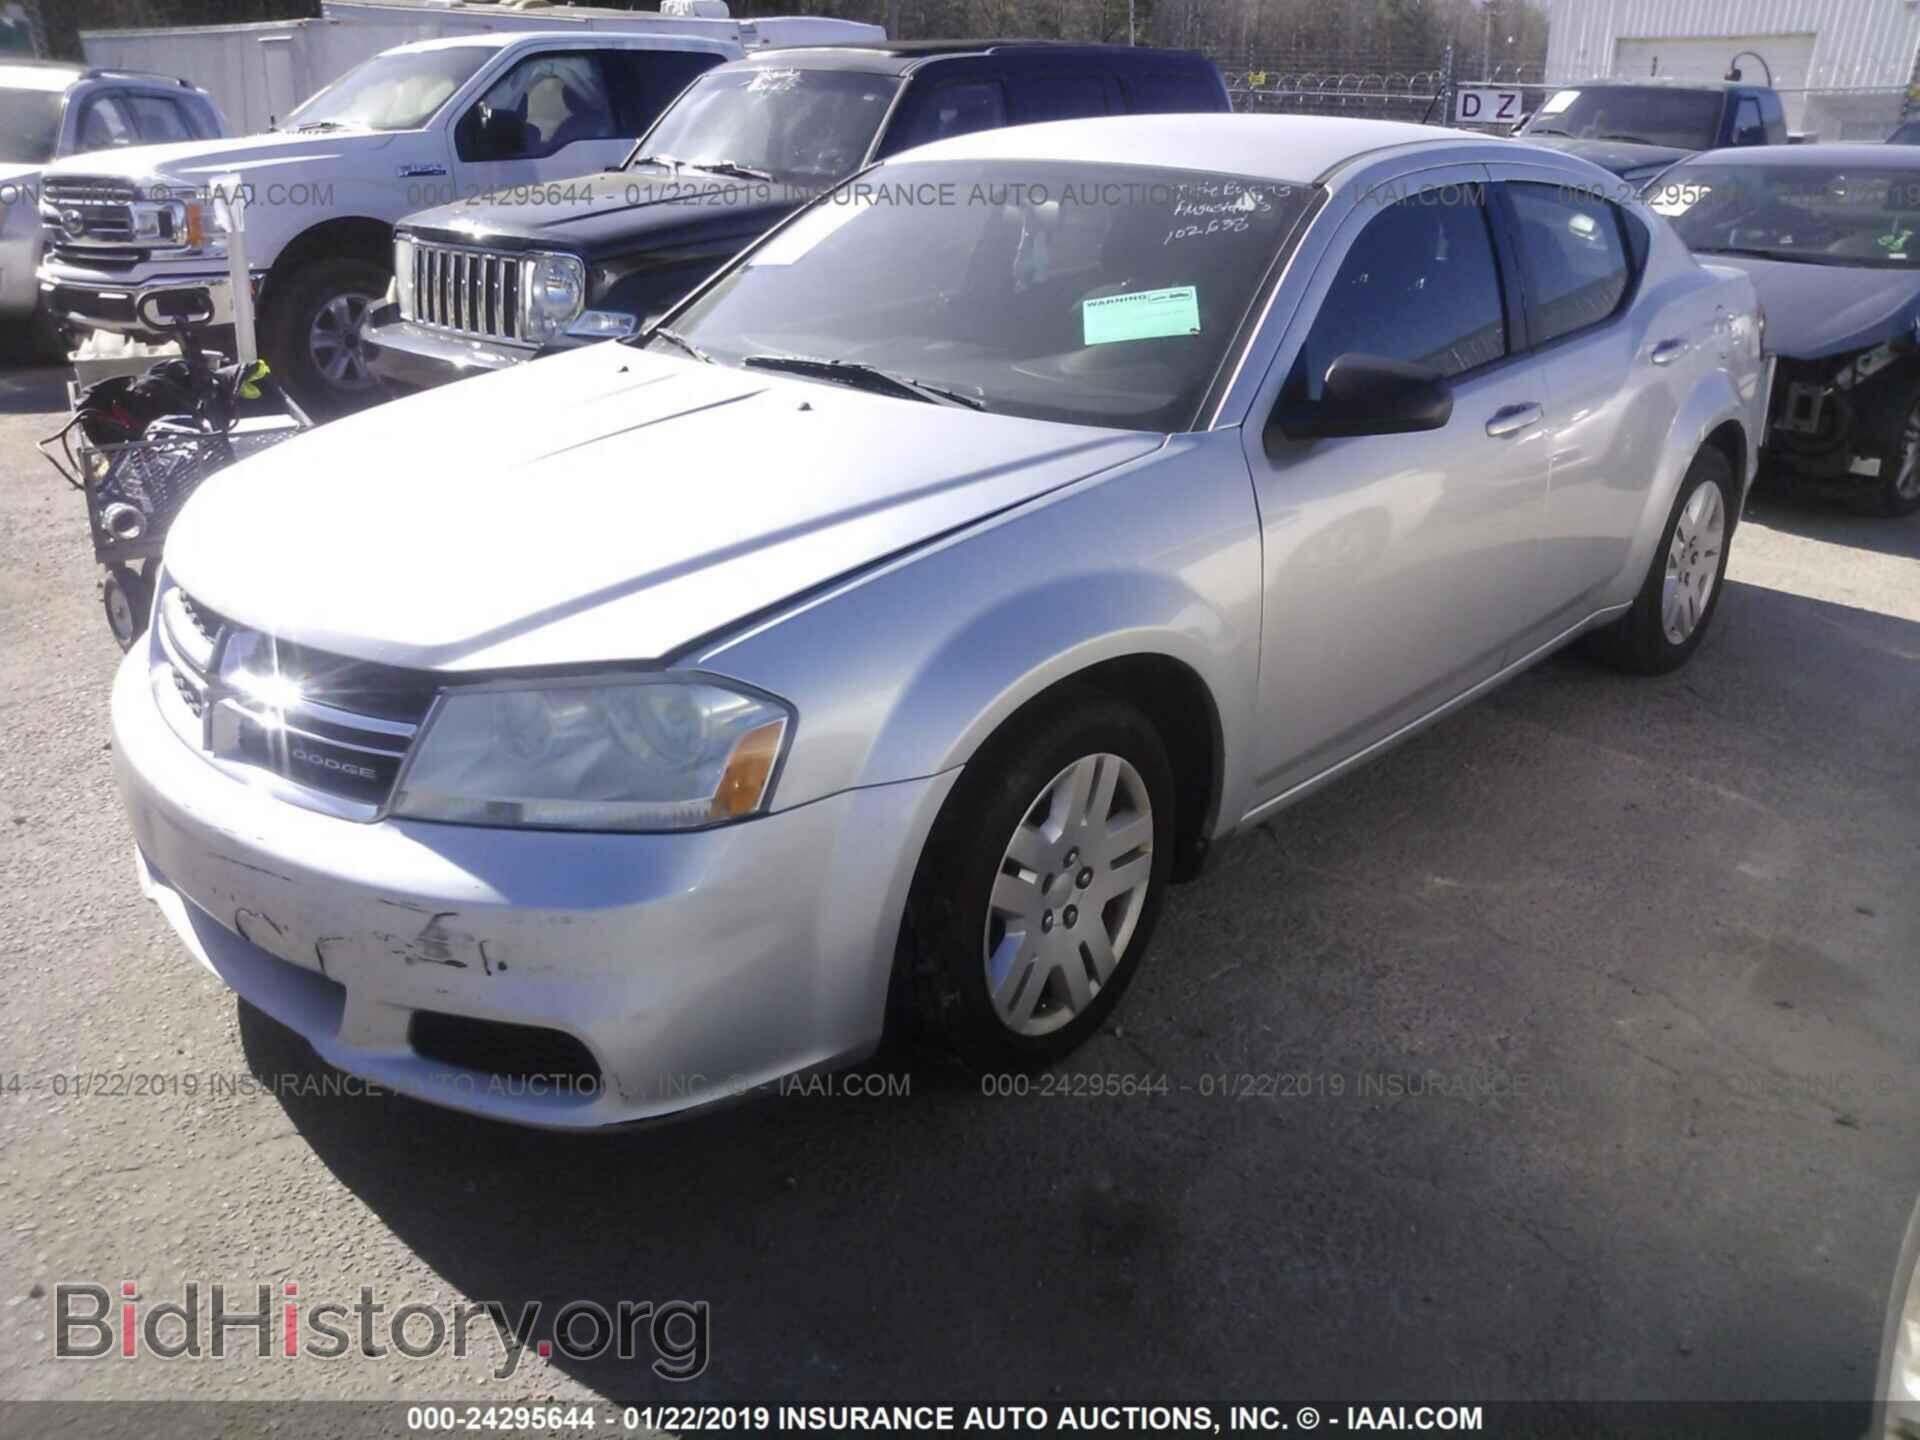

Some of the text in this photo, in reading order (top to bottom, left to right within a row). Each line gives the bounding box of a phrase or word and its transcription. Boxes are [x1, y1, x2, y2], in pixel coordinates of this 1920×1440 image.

[1462, 93, 1516, 118] D Z
[293, 751, 377, 778] DODGE
